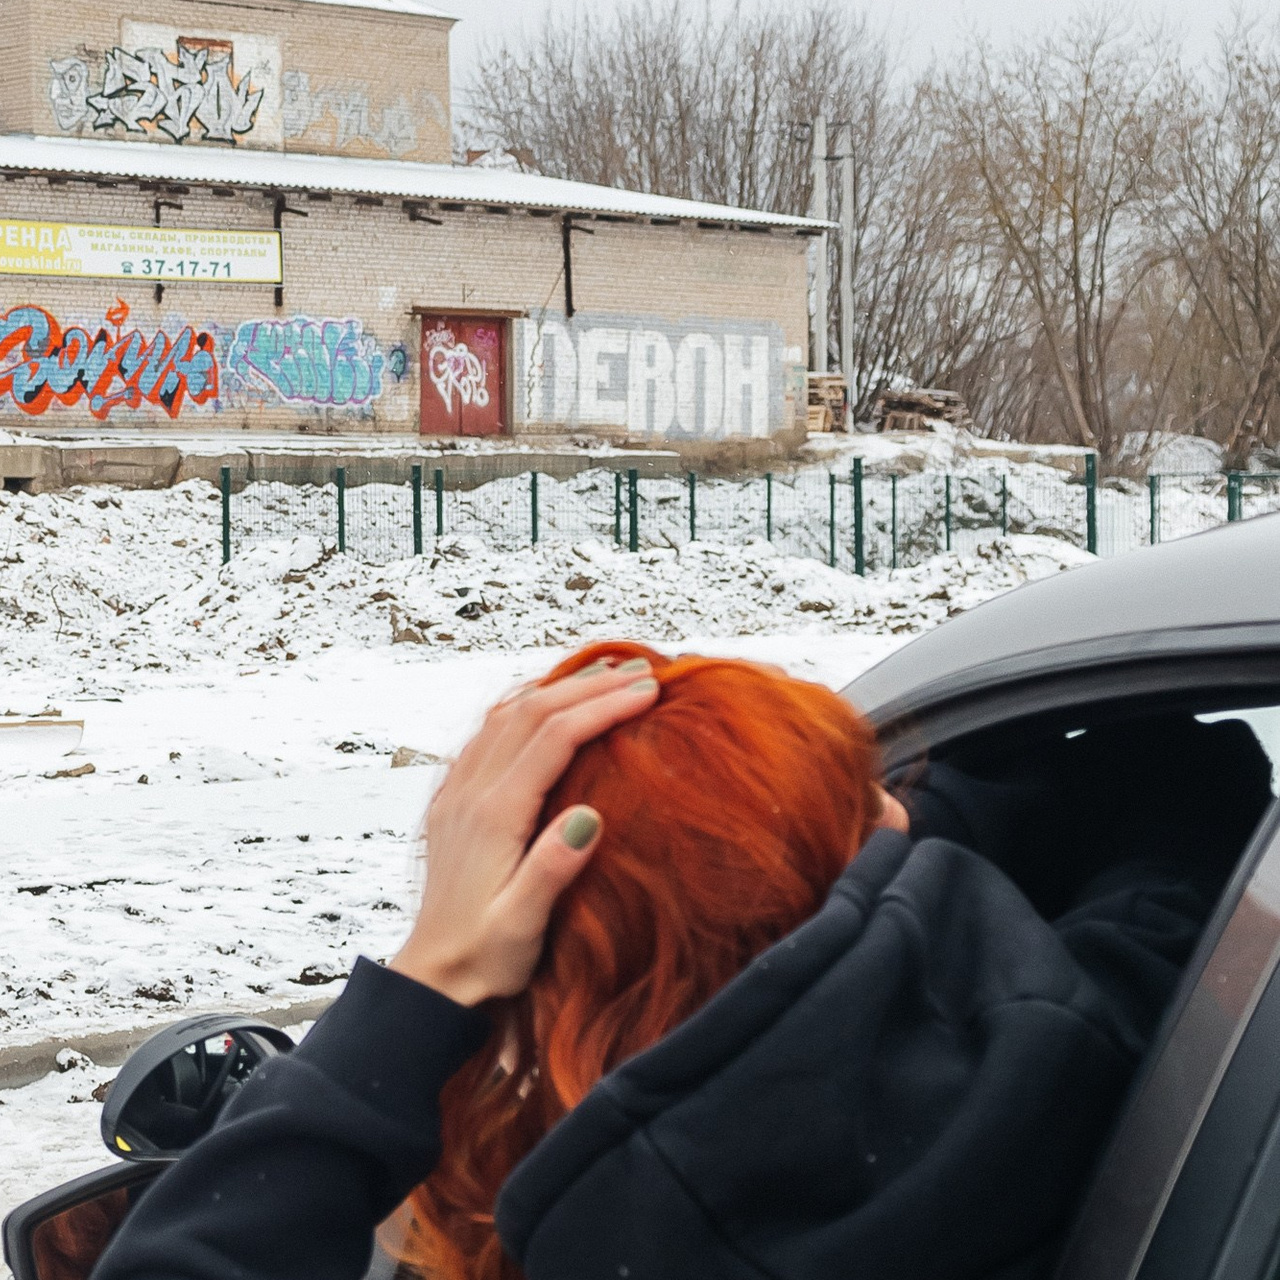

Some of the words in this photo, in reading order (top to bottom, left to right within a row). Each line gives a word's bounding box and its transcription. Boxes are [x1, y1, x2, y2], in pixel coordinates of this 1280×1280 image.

[78, 228, 125, 241] ОФИСЫ,
[129, 232, 181, 244] СКЛАДЫ,
[185, 234, 273, 245] ПРОИЗВОДСТВА
[91, 242, 159, 255] МАГАЗИНЫ,
[162, 246, 197, 257] КАФЕ,
[200, 247, 268, 258] СПОРТЗАЛЫ
[141, 258, 233, 278] 37-17-71
